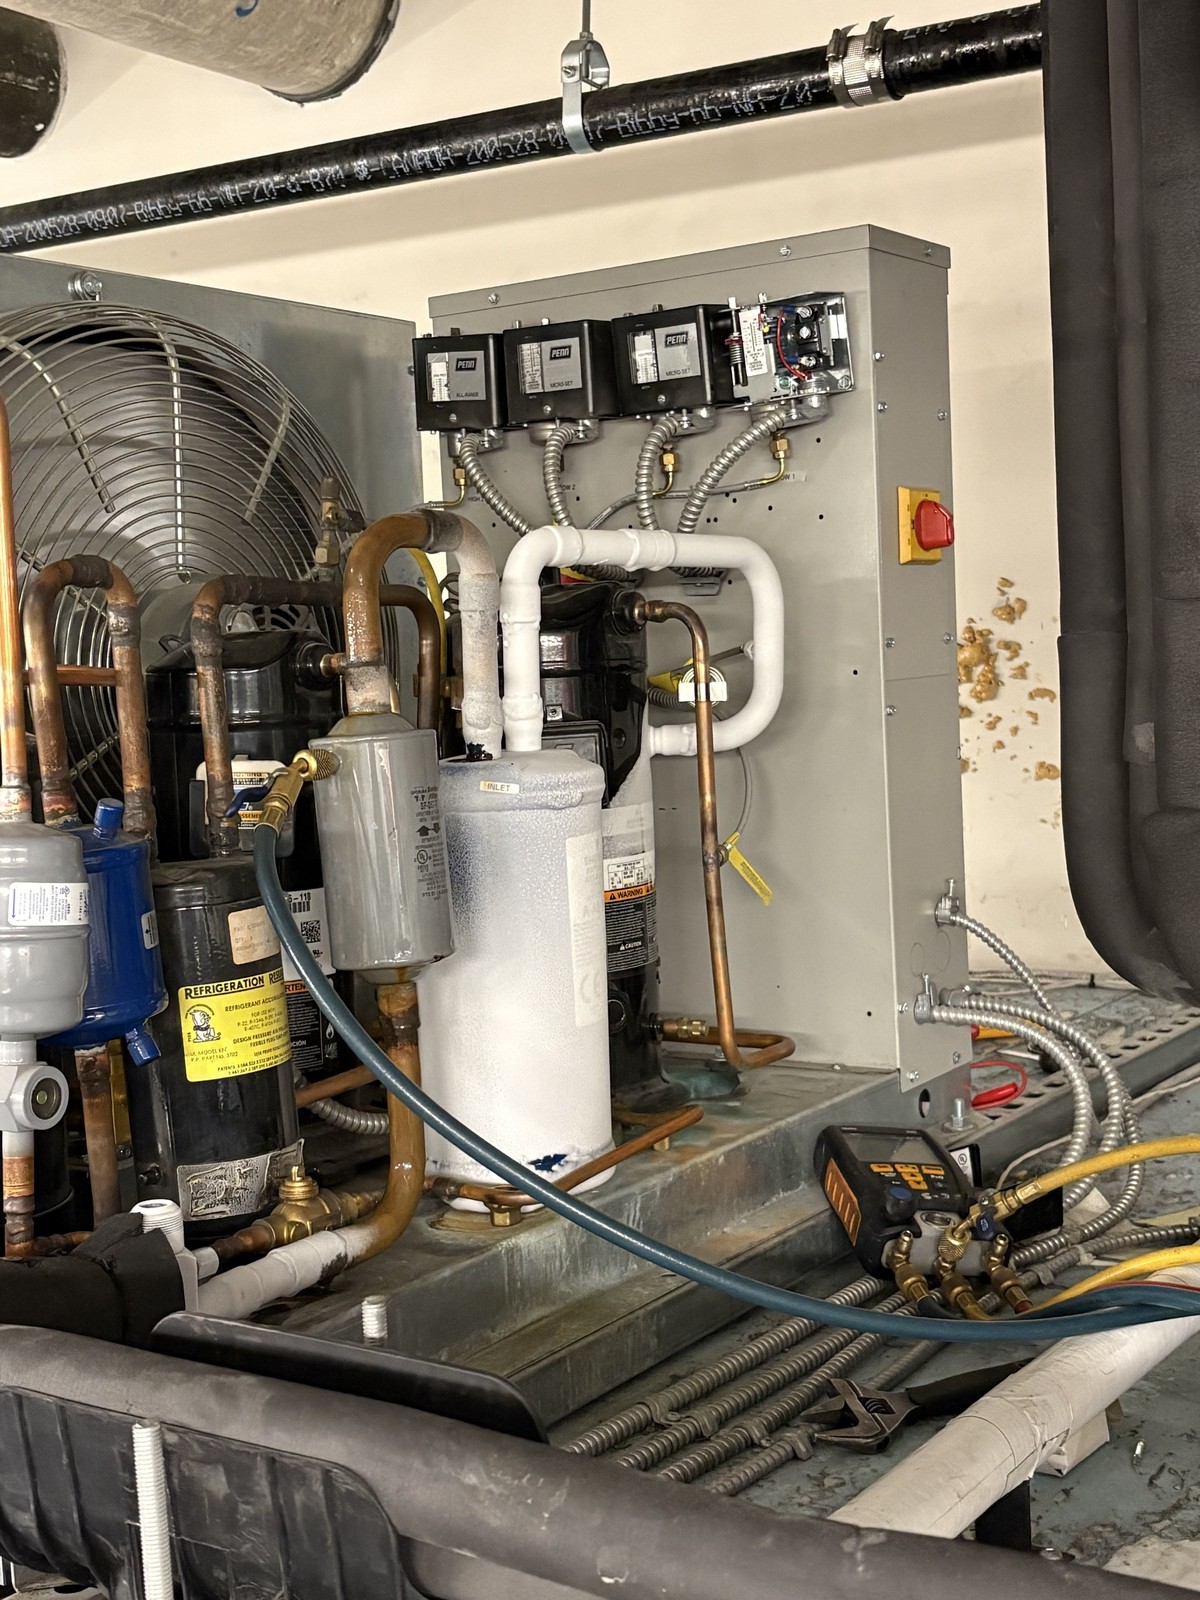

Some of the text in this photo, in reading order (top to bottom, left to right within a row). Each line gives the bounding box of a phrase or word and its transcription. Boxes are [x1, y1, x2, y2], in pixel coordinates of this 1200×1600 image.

[488, 783, 511, 792] INLET
[616, 889, 643, 900] WARNING
[625, 941, 642, 949] CAUTION
[184, 976, 264, 1000] REFRIGERATION
[225, 1000, 261, 1012] REFRIGERANT
